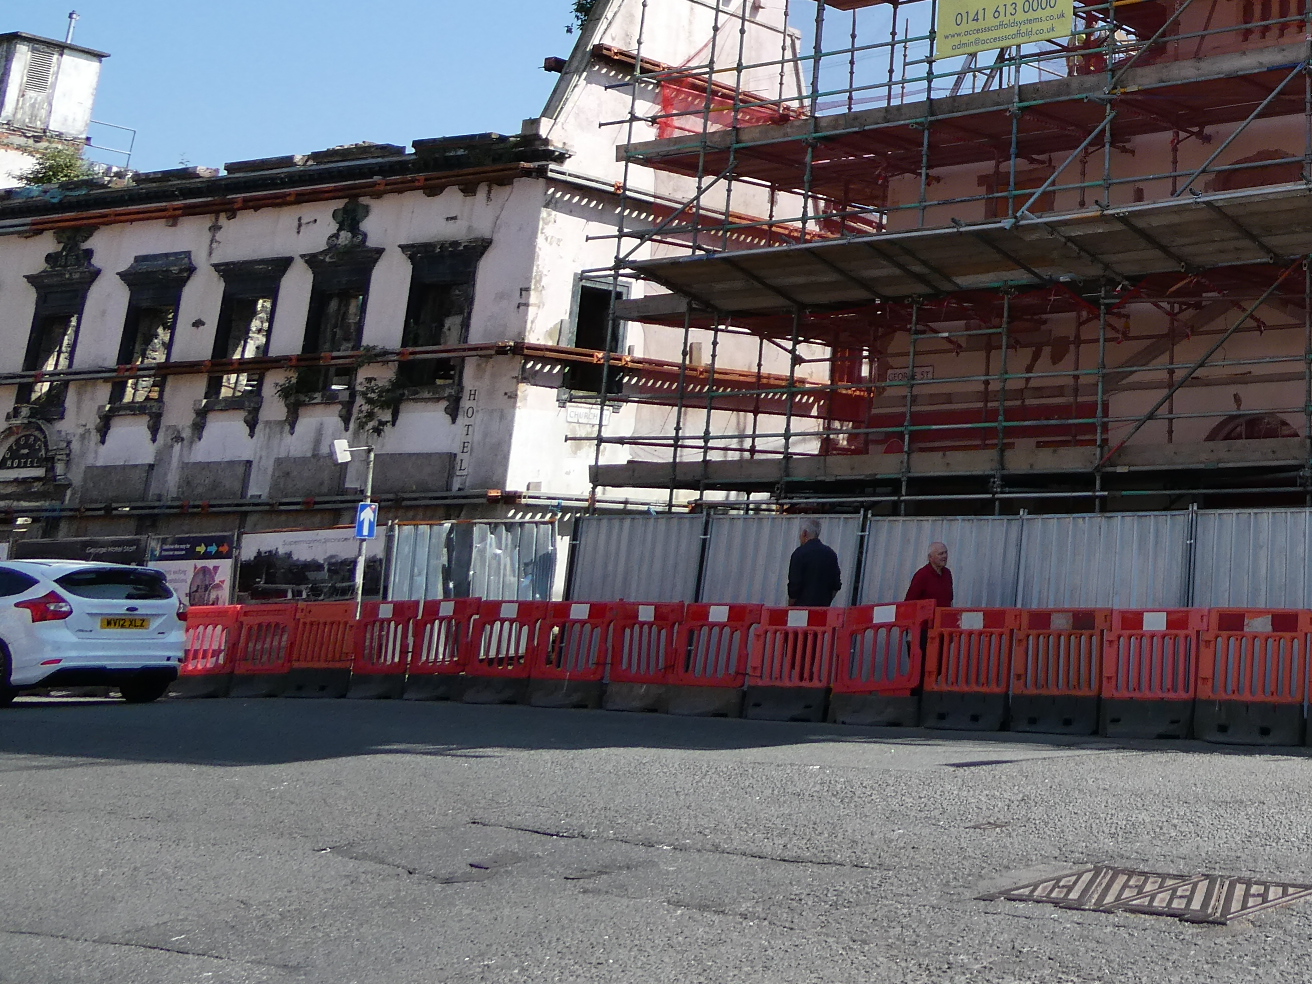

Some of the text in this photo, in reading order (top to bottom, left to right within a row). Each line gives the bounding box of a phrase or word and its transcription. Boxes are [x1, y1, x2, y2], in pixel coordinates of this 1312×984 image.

[955, 7, 987, 26] 0141
[993, 2, 1018, 20] 613
[944, 10, 1066, 40] www.accessscaffoldsystems.co.uk
[951, 24, 1056, 51] admin@accessscaffold.co.uk
[888, 372, 918, 382] GEORE
[569, 410, 598, 421] CHURCH
[458, 389, 477, 471] HOTEL
[7, 458, 40, 467] HOTEL
[128, 618, 145, 627] XLZ
